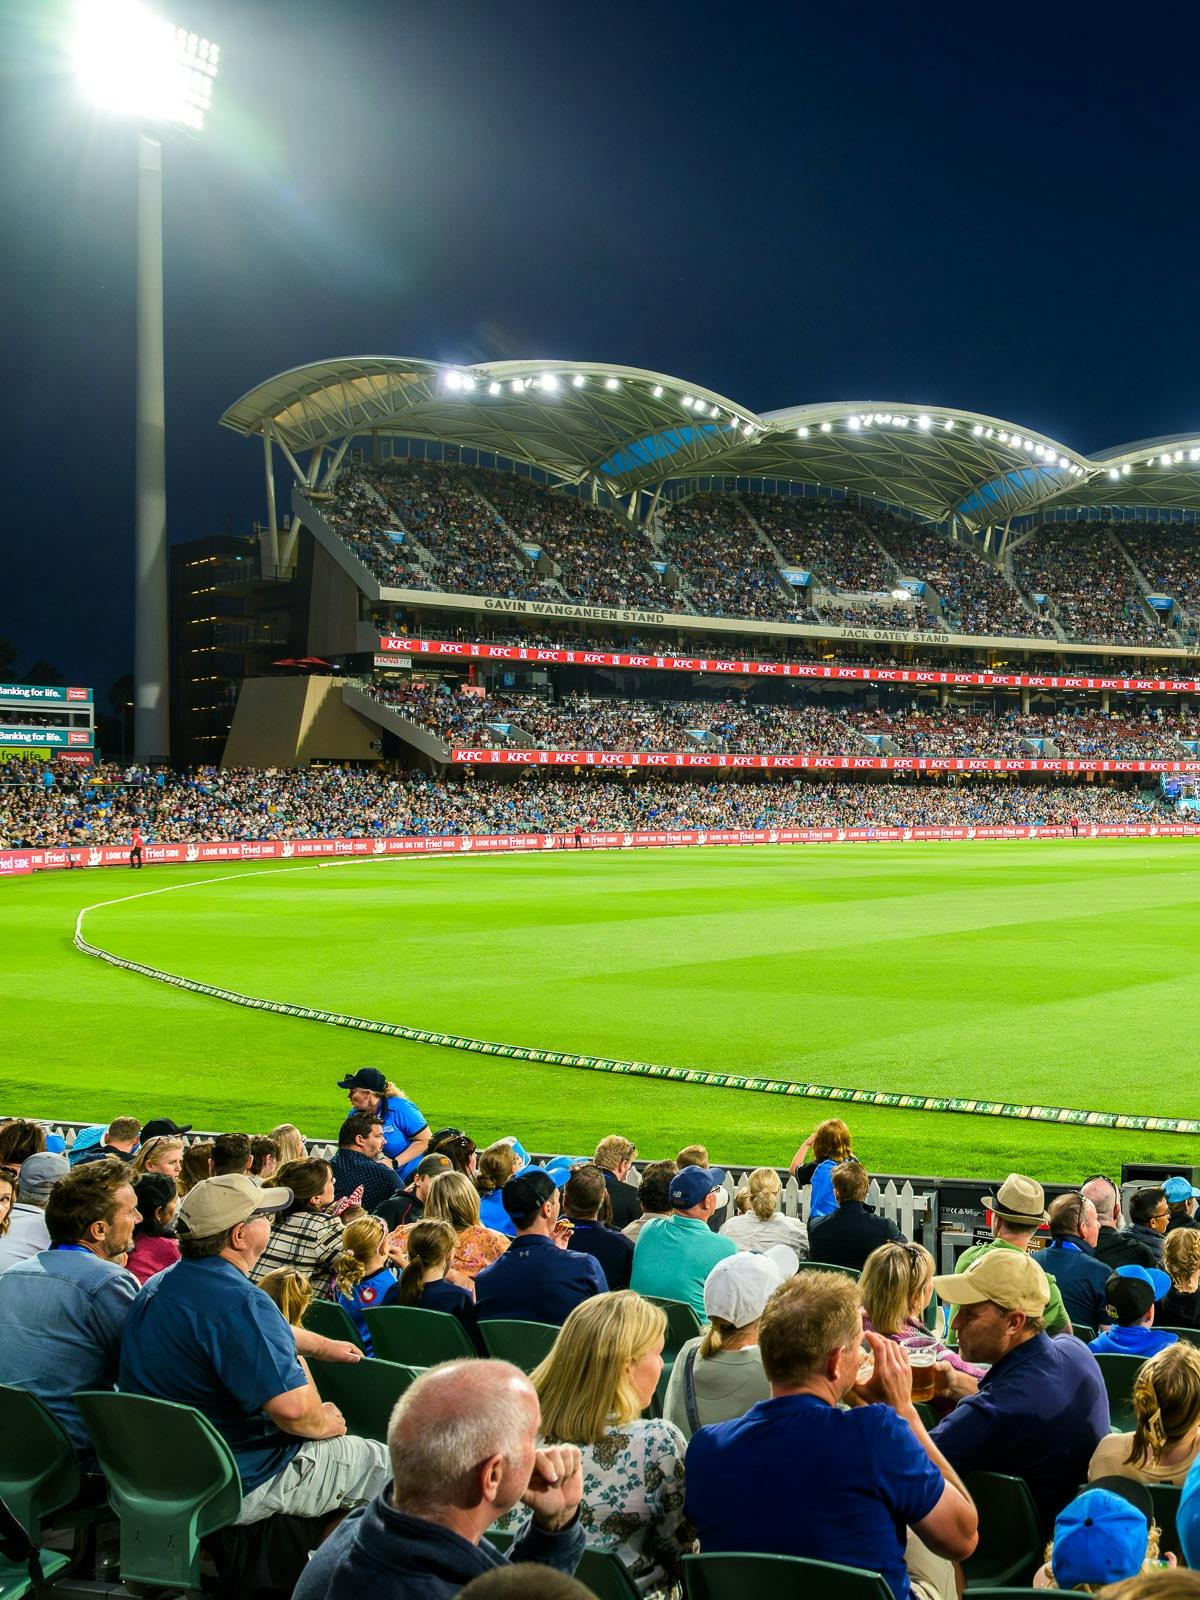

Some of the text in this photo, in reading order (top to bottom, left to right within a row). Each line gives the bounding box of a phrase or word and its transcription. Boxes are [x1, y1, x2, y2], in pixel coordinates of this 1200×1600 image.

[484, 598, 665, 624] GAVIN WANGANEEN STAND
[841, 629, 949, 644] JACK OATEY STAND
[387, 640, 411, 649] KFC
[440, 644, 462, 653] KFC
[489, 648, 511, 656] KFC
[537, 651, 558, 660] KFC
[584, 654, 604, 663] KFC
[629, 657, 649, 665] KFC
[673, 660, 692, 668] KFC
[758, 665, 777, 673] KFC
[798, 667, 817, 675] KFC
[838, 669, 856, 677] KFC
[878, 671, 895, 679] KFC
[31, 688, 44, 696] for
[32, 733, 45, 741] for
[457, 752, 483, 760] KFC
[507, 753, 532, 761] KFC
[555, 754, 578, 762] KFC
[601, 755, 624, 763] KFC
[647, 756, 669, 764] KFC
[690, 756, 711, 764] KFC
[733, 757, 754, 765] KFC
[774, 756, 794, 765] KFC
[815, 757, 834, 766] KFC
[854, 759, 874, 767] KFC
[893, 758, 912, 767] KFC
[298, 844, 312, 852] LOOK
[313, 844, 322, 852] ON
[322, 843, 334, 851] THE
[335, 841, 353, 851] Fried
[425, 838, 442, 849] Fried
[498, 838, 508, 846] THE
[509, 836, 526, 847] Fried
[105, 851, 121, 860] LOOK
[145, 847, 165, 859] Fried
[166, 849, 180, 857] SIDE
[202, 848, 216, 856] LOOK
[216, 847, 228, 855] ON
[229, 846, 240, 854] THE
[241, 844, 260, 855] Fried
[31, 855, 43, 864] THE
[44, 852, 65, 863] Fried
[14, 859, 29, 869] SIDE
[976, 1229, 993, 1238] SECTIO
